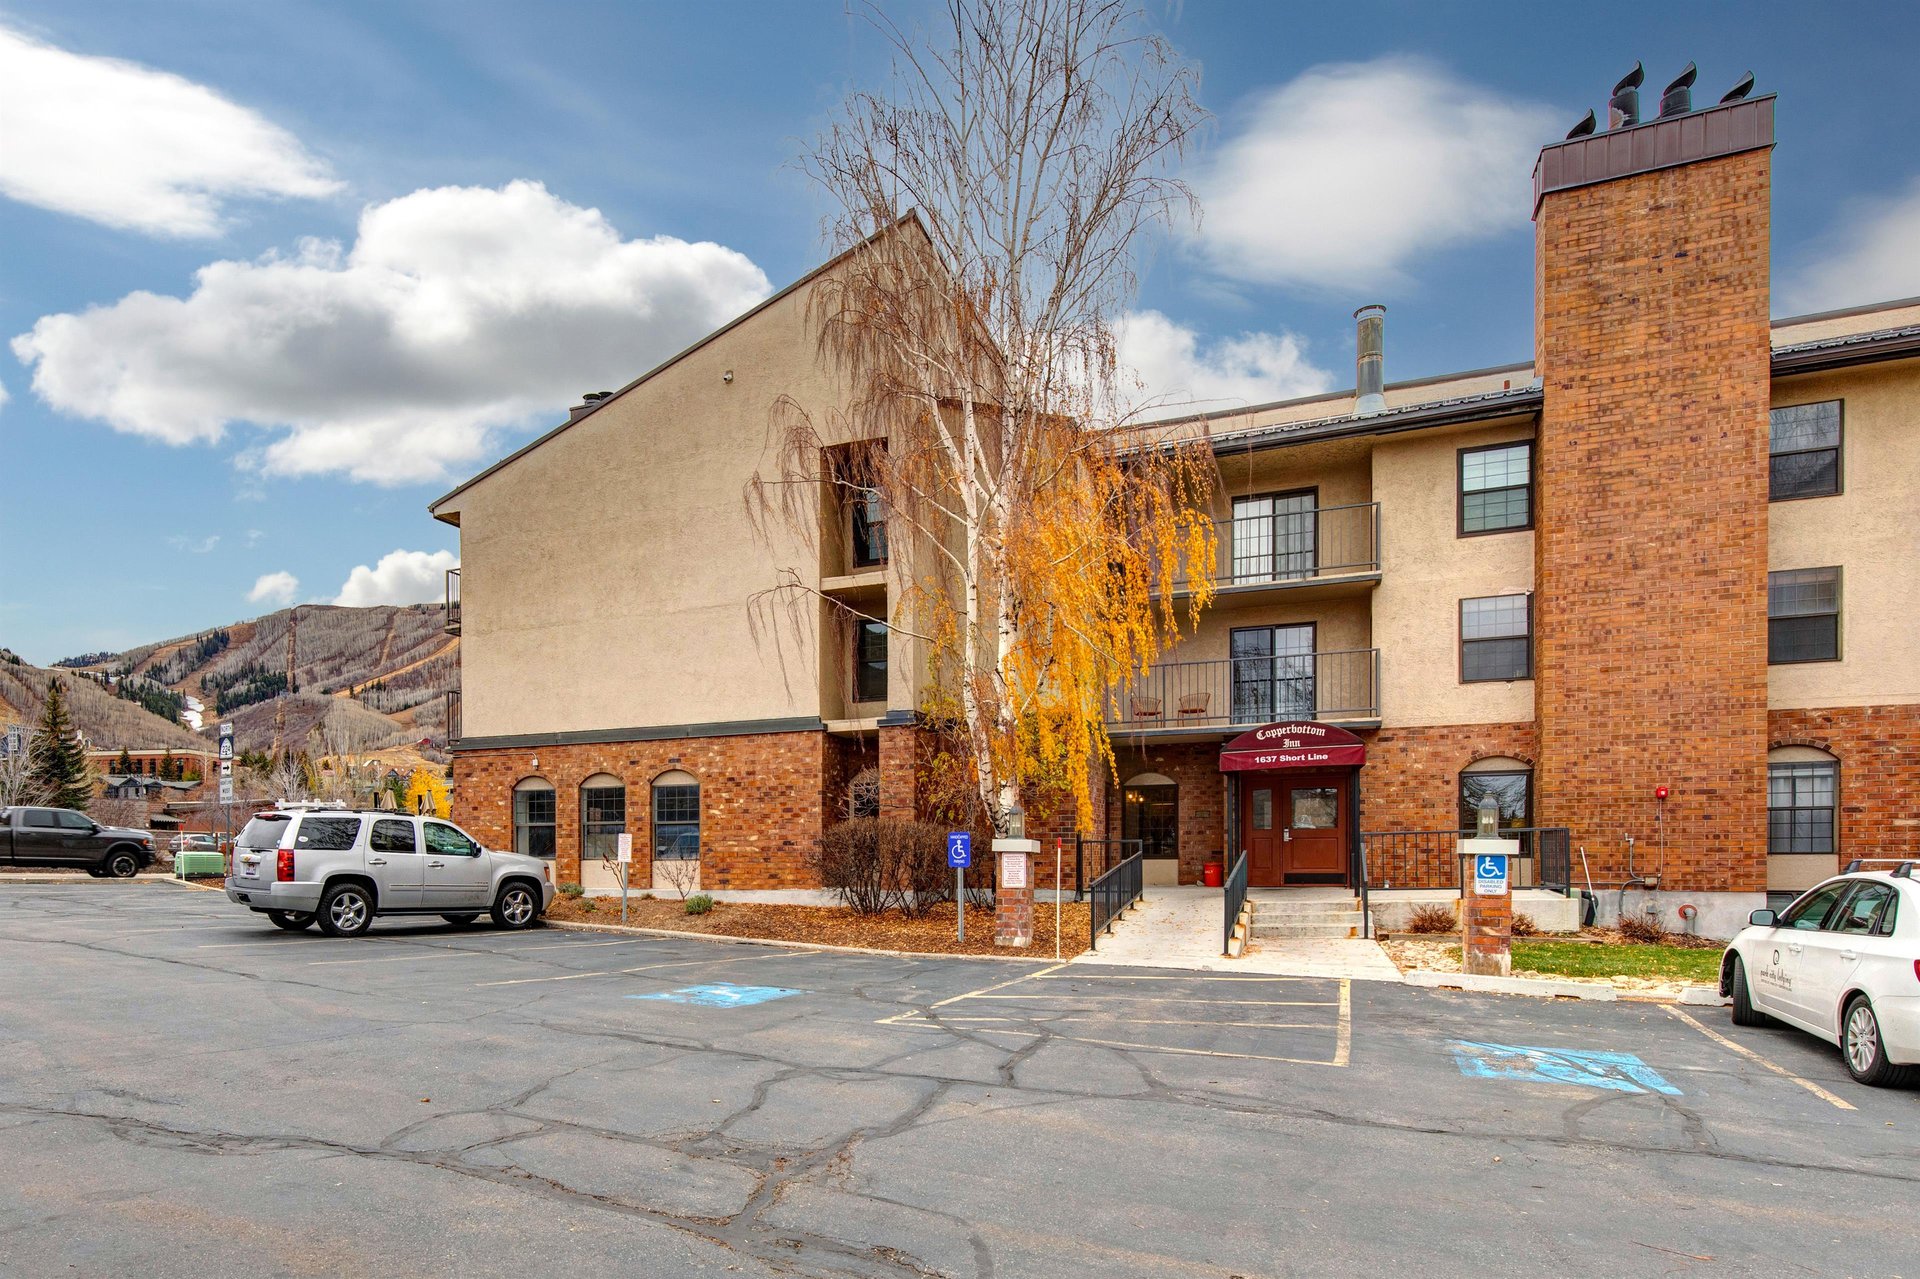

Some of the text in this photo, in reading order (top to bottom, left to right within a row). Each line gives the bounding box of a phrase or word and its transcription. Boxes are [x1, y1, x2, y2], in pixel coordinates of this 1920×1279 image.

[1256, 724, 1326, 740] Copperbottom
[1283, 738, 1300, 748] Inn
[1254, 756, 1277, 764] 1637
[1760, 964, 1768, 977] park
[1769, 970, 1777, 982] city
